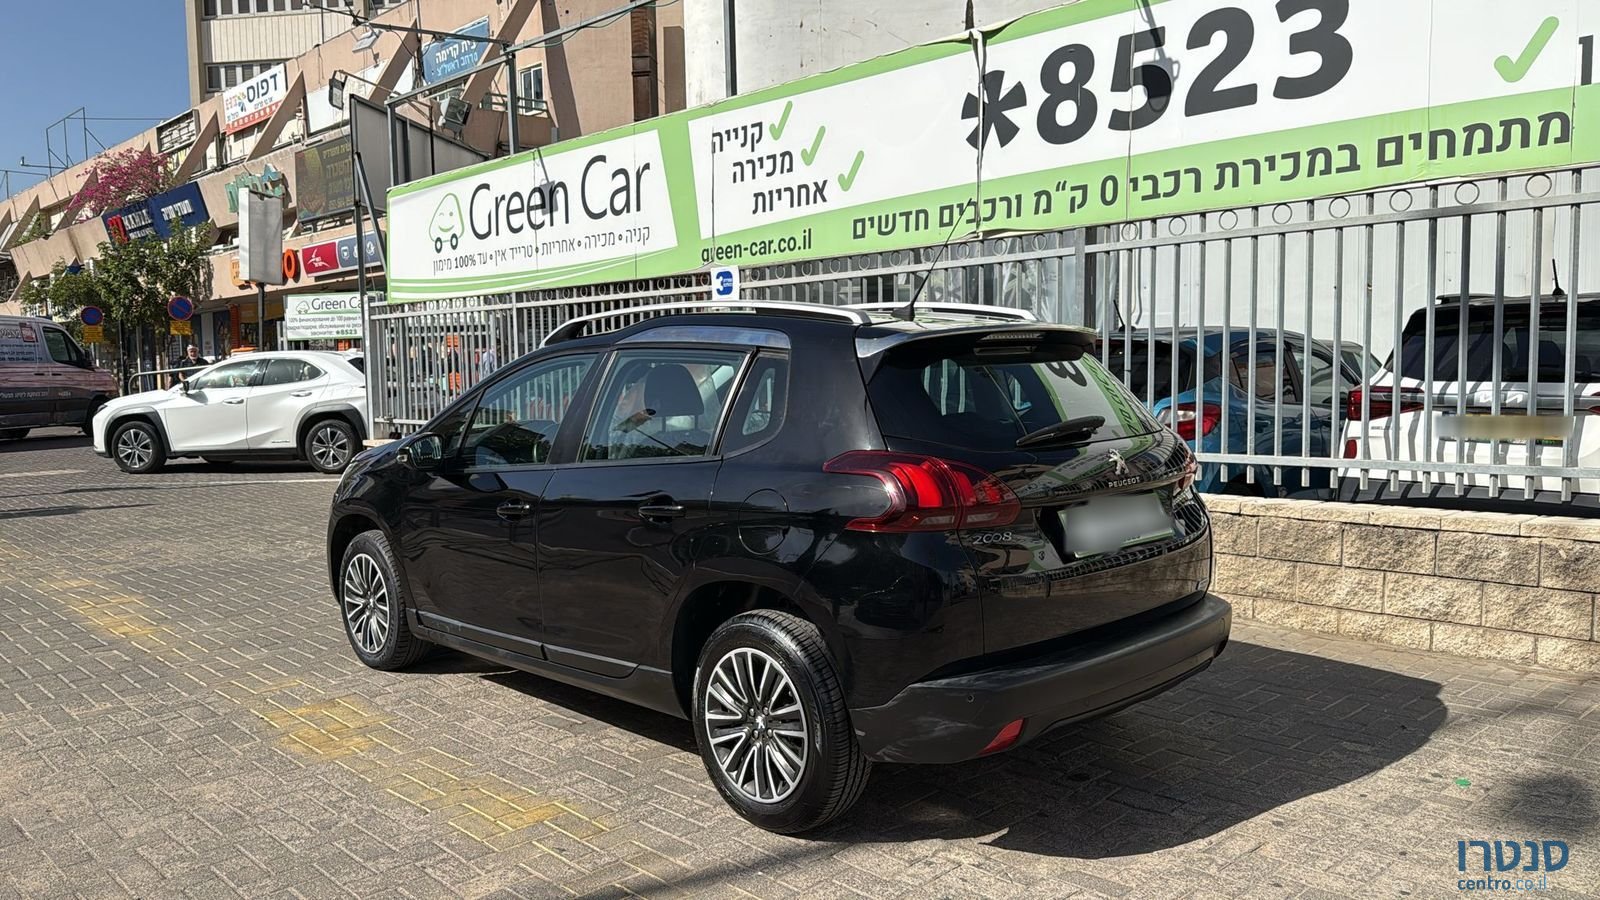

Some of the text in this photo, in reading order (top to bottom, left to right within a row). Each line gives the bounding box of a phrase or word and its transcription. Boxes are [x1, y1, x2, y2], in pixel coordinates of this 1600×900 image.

[246, 73, 278, 103] דפוס
[711, 121, 763, 154] קנייה
[1377, 110, 1571, 168] מתמחים
[733, 150, 794, 184] מכירה
[1214, 142, 1361, 191] במכירת
[469, 154, 651, 241] Green Car
[752, 179, 828, 215] אחריות
[1131, 167, 1202, 202] רכבי
[852, 208, 929, 240] חדשים
[938, 193, 1022, 229] ורכבים
[433, 226, 650, 276] קניה מכירה אחריות טרייד אין עד 100% מימון
[311, 296, 362, 311] Green Ca
[1108, 476, 1141, 489] PEUGEOT
[972, 531, 1013, 546] 2008
